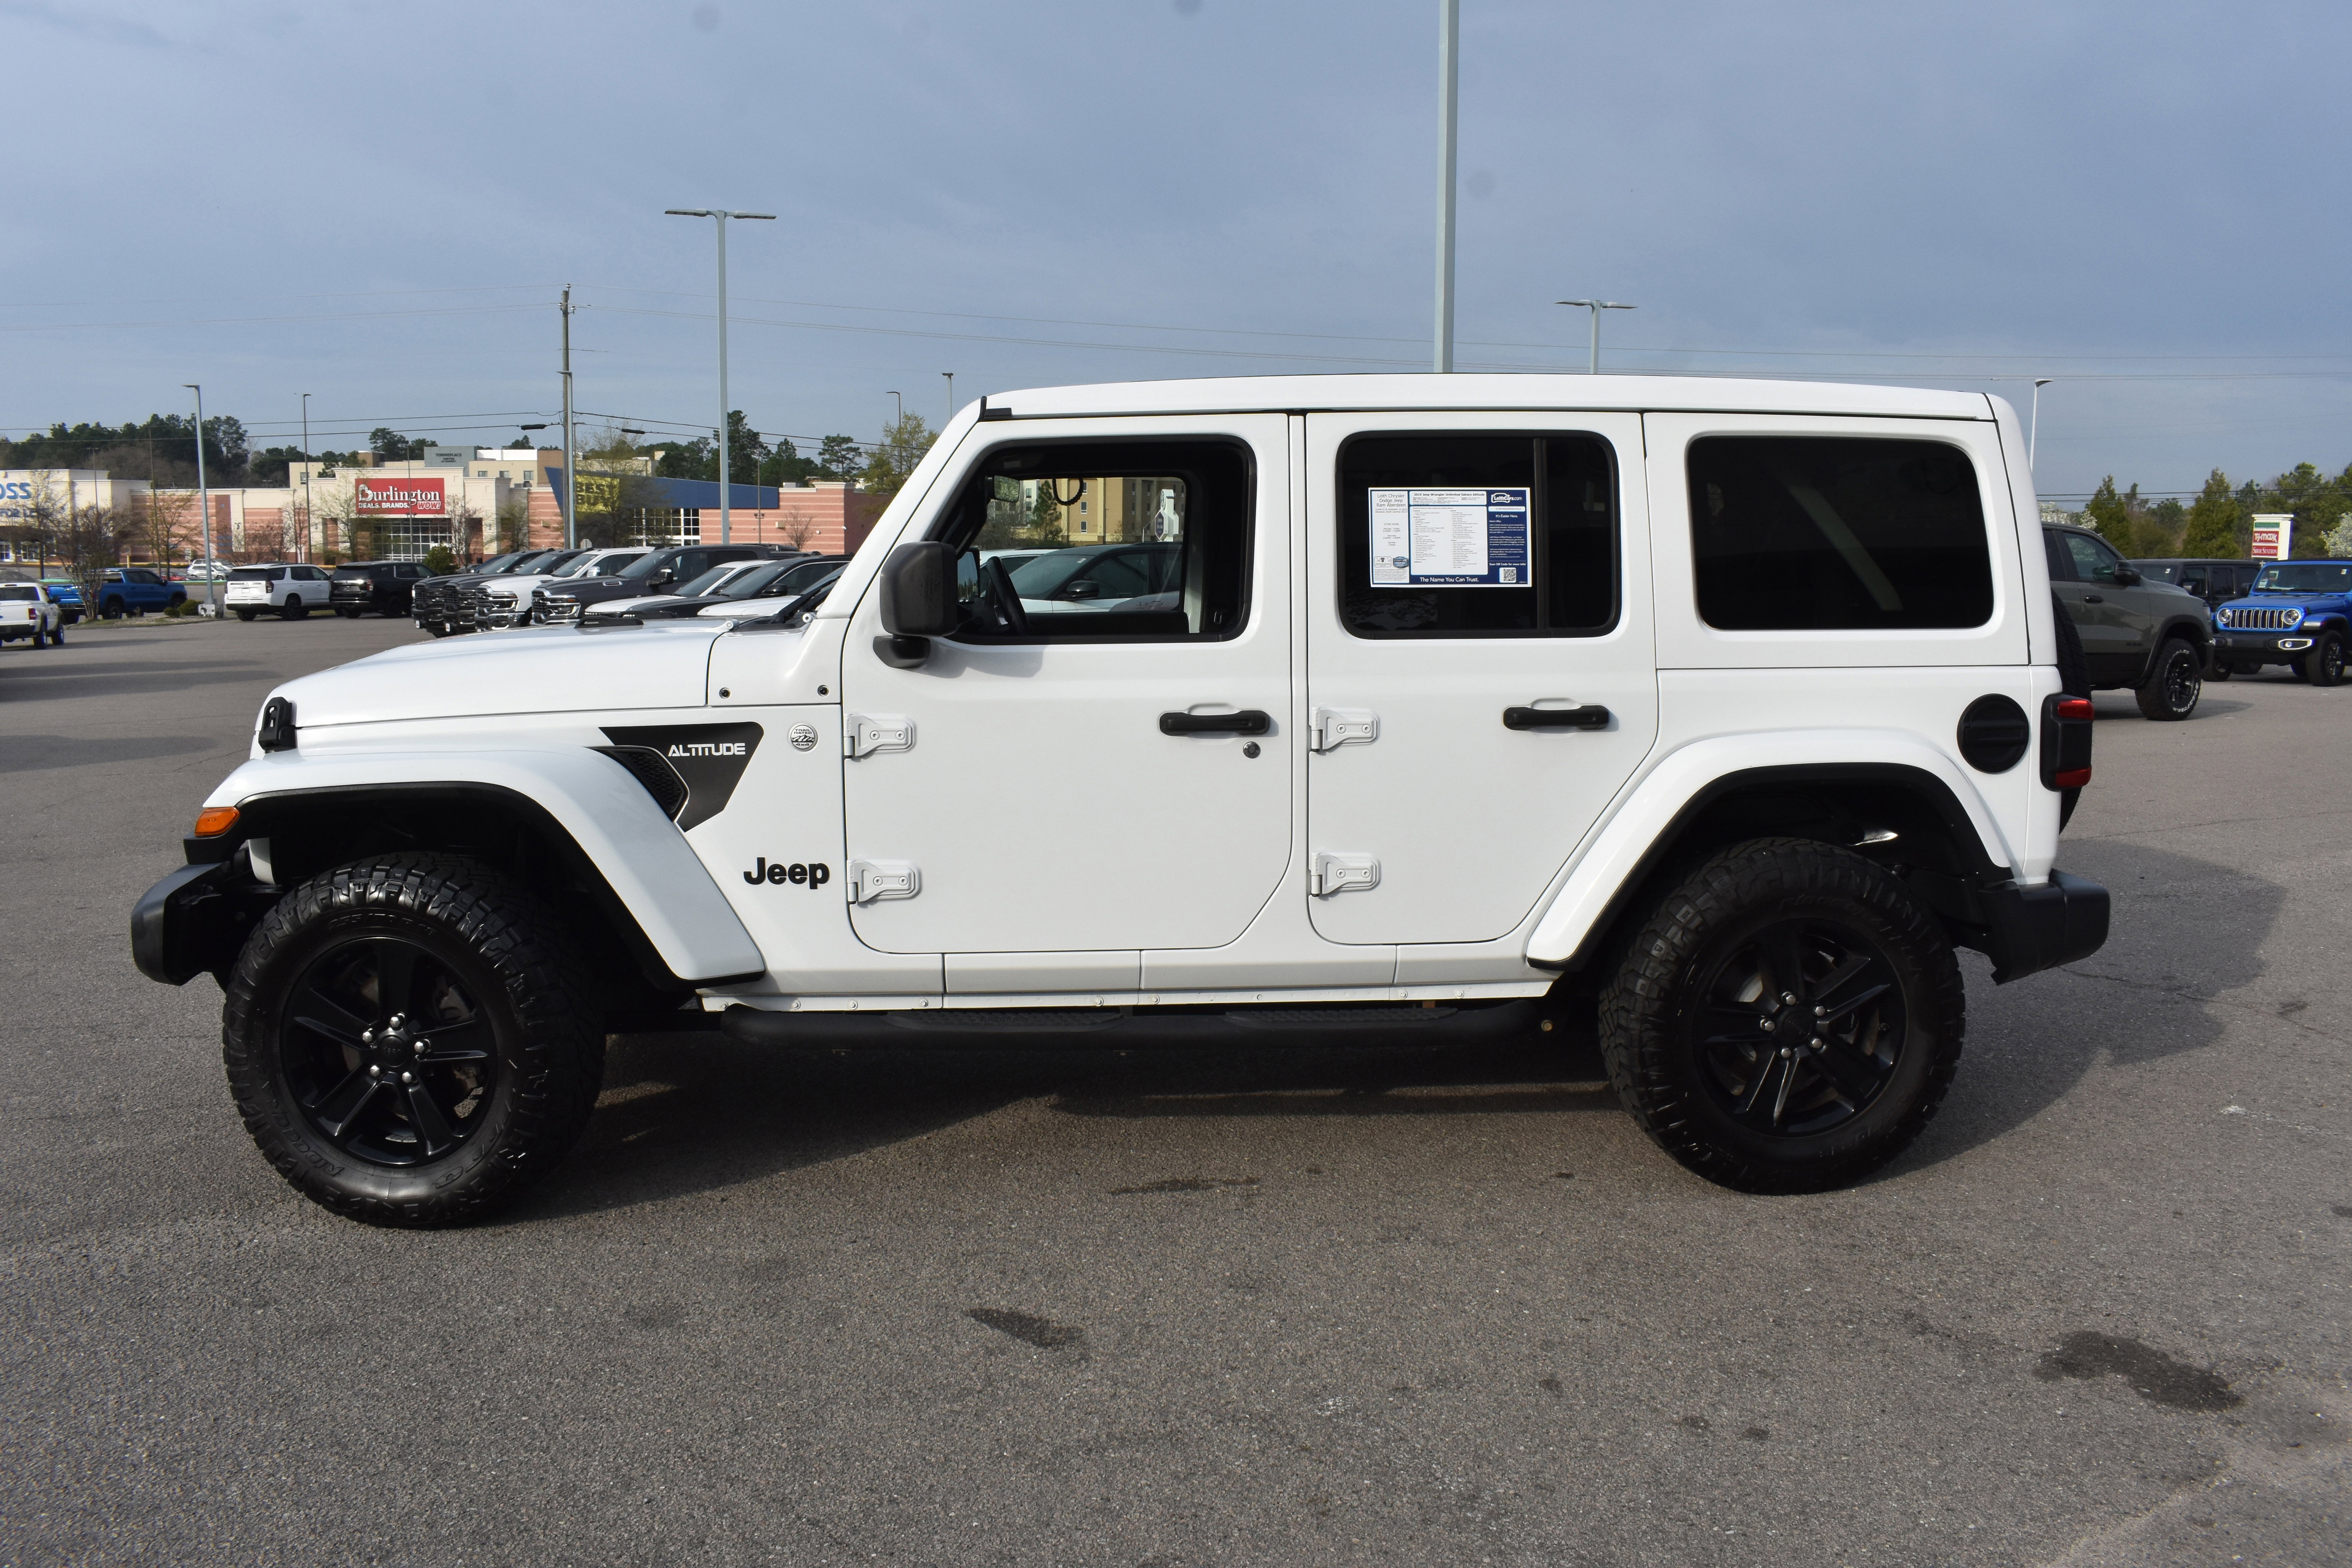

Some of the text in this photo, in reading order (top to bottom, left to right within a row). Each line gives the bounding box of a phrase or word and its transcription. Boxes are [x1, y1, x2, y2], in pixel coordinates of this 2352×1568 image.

[359, 484, 440, 506] Burlington
[417, 501, 441, 510] WOW!
[668, 742, 746, 757] ALTITUDE
[743, 857, 830, 890] Jeep
